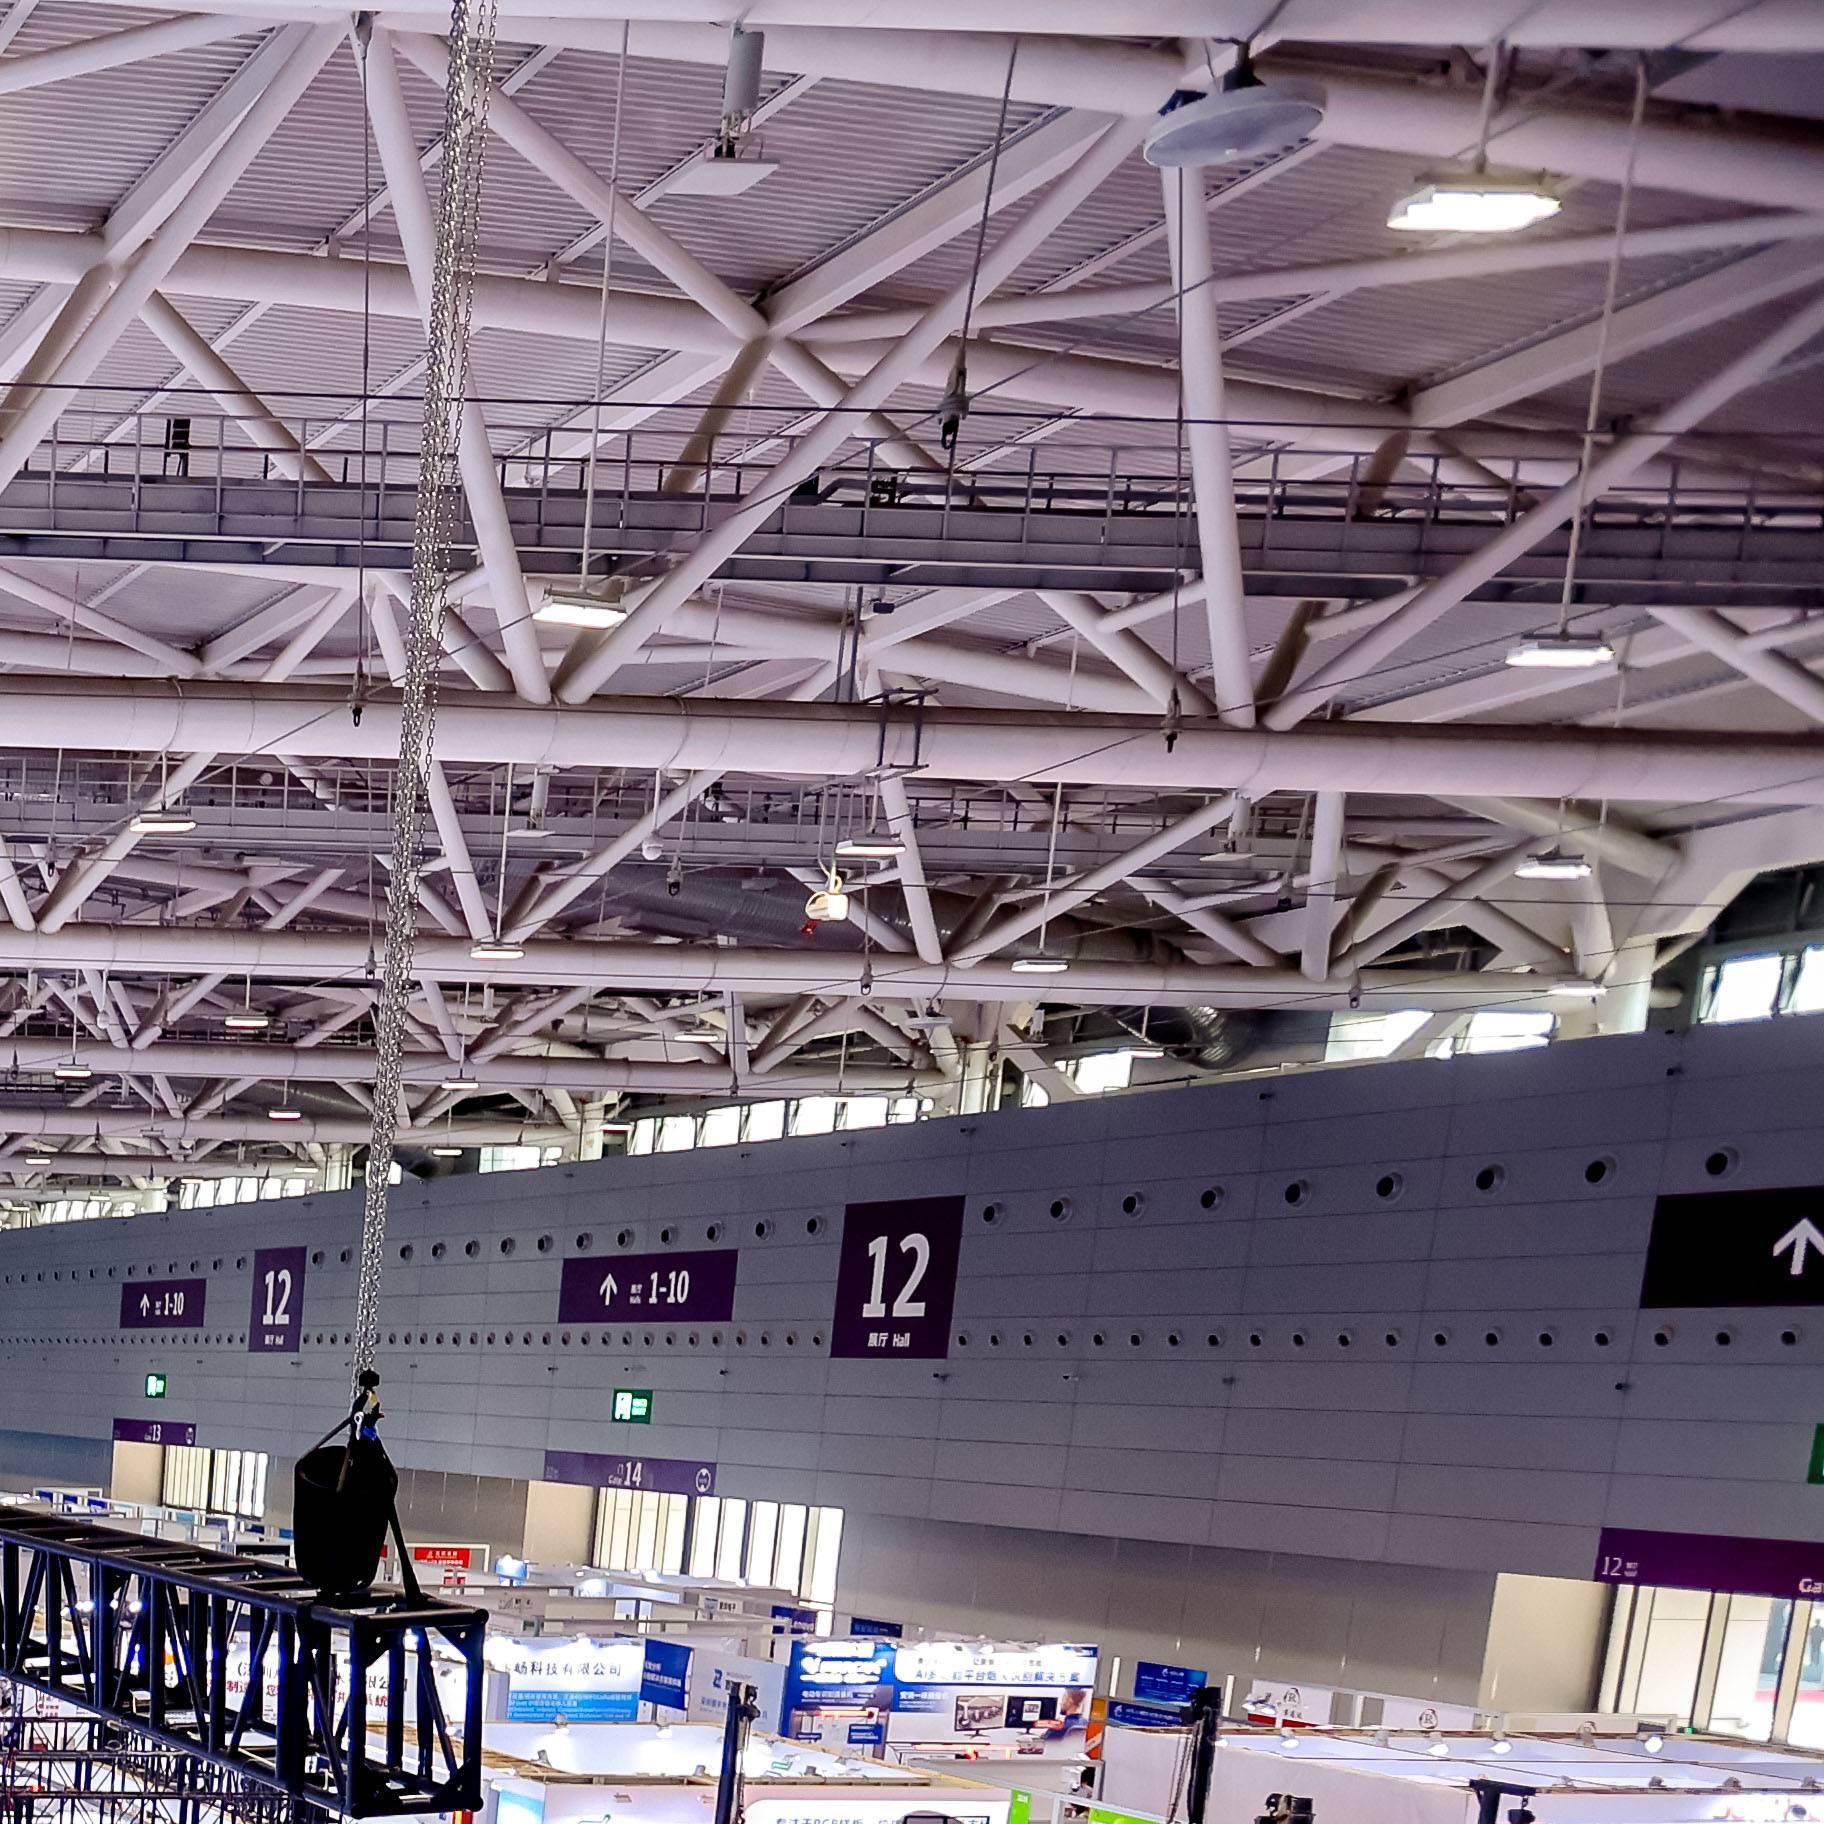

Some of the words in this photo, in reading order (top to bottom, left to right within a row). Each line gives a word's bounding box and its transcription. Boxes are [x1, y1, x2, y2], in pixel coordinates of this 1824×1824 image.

[649, 1270, 689, 1304] 1-10
[863, 1233, 930, 1318] 12
[164, 1292, 184, 1316] 1-10
[263, 1269, 292, 1325] 12
[624, 1461, 642, 1487] 14
[1601, 1556, 1622, 1576] 12
